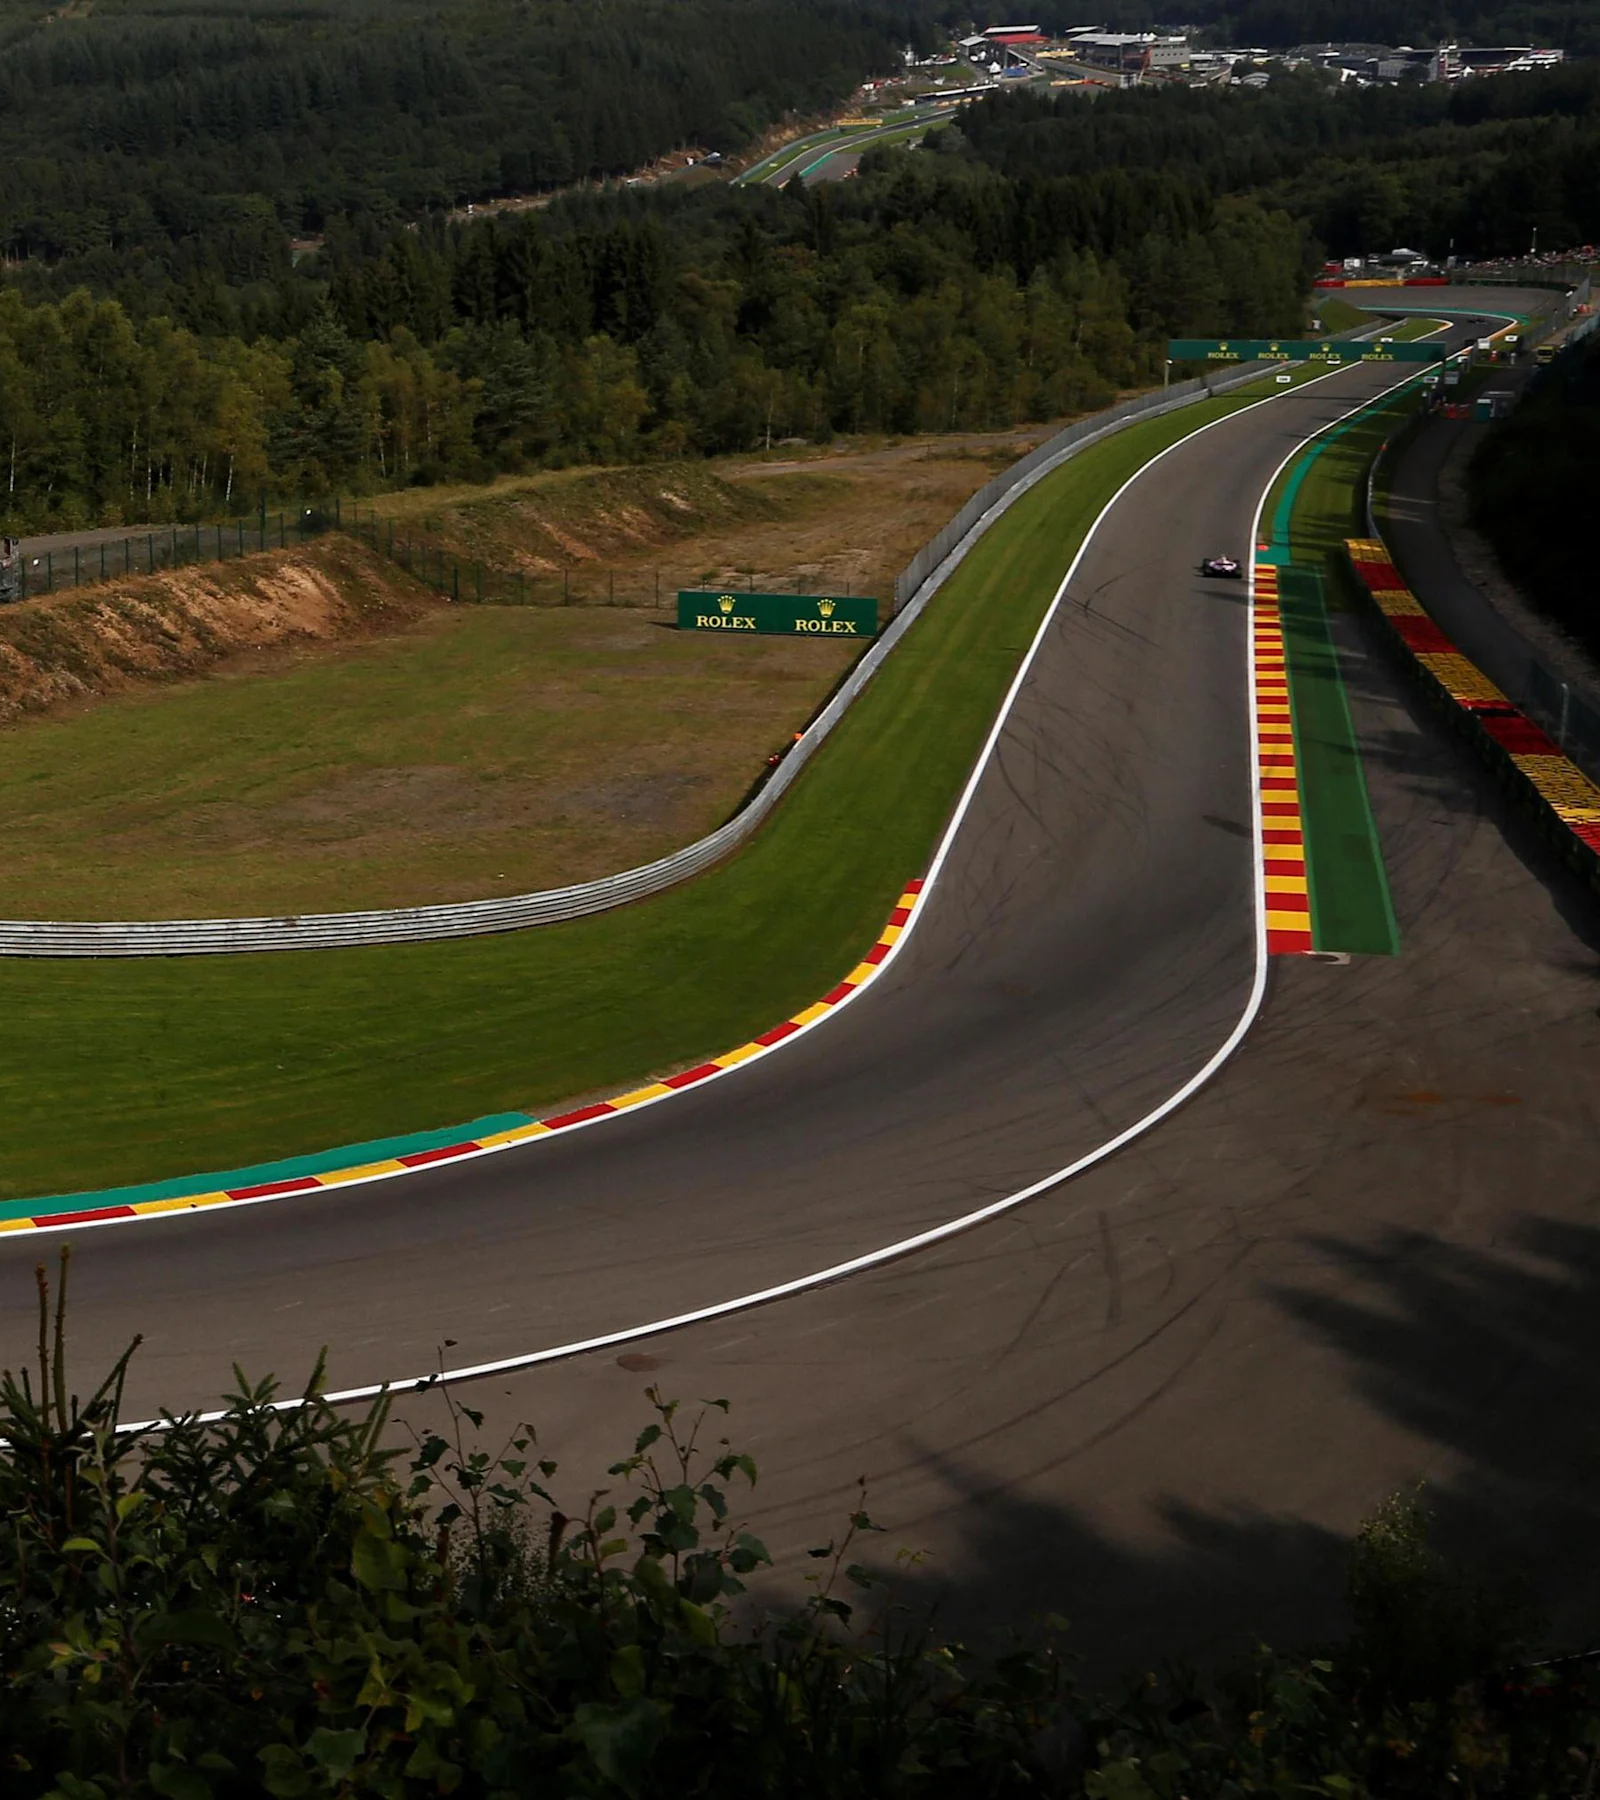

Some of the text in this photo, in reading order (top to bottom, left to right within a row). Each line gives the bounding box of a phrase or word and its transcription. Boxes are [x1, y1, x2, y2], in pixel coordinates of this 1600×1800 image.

[1309, 352, 1341, 360] ROLEX
[696, 615, 756, 629] ROLEX
[794, 619, 856, 633] ROLEX
